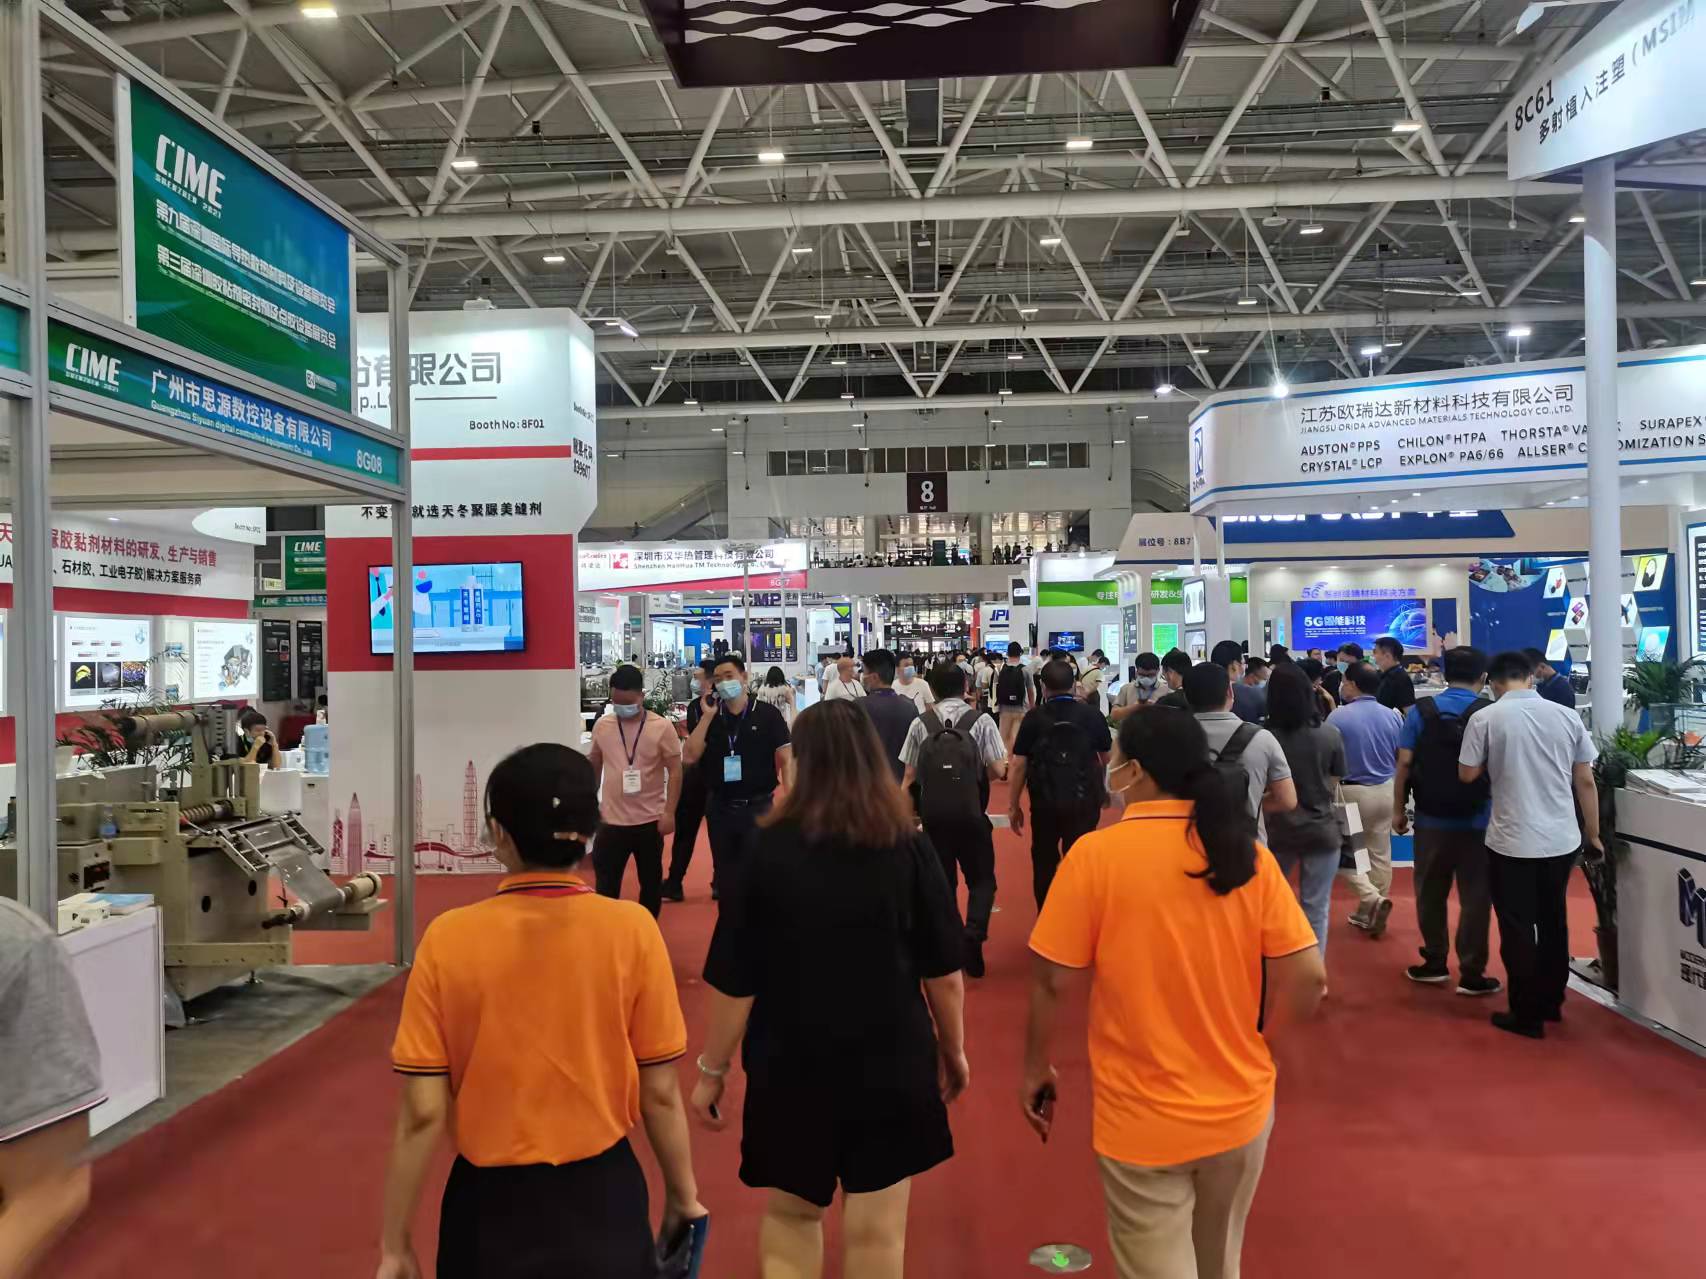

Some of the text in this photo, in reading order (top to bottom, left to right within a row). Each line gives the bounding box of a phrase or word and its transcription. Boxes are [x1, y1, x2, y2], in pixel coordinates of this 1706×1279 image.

[1515, 79, 1554, 131] 8C61
[155, 134, 226, 209] CIME
[65, 343, 122, 386] CIME
[151, 369, 332, 451] 广州市思源数控设备有限公司
[1301, 384, 1573, 424] 江苏欧瑞达新材料科技有限公司
[469, 420, 500, 430] Booth
[521, 419, 545, 429] 8F01
[1301, 422, 1336, 434] JIANGSU
[1338, 421, 1366, 432] ORIDA
[1368, 417, 1416, 429] ADVANCED
[1419, 413, 1468, 425] MATERIALS
[1470, 408, 1533, 421] TECHNOLOGY
[1357, 440, 1381, 452] PPS
[1454, 432, 1487, 445] HTPA
[356, 450, 383, 474] 8G08
[1361, 457, 1382, 469] LCP
[1460, 448, 1504, 462] PA6/66
[921, 481, 934, 502] 8
[294, 541, 321, 552] CIME
